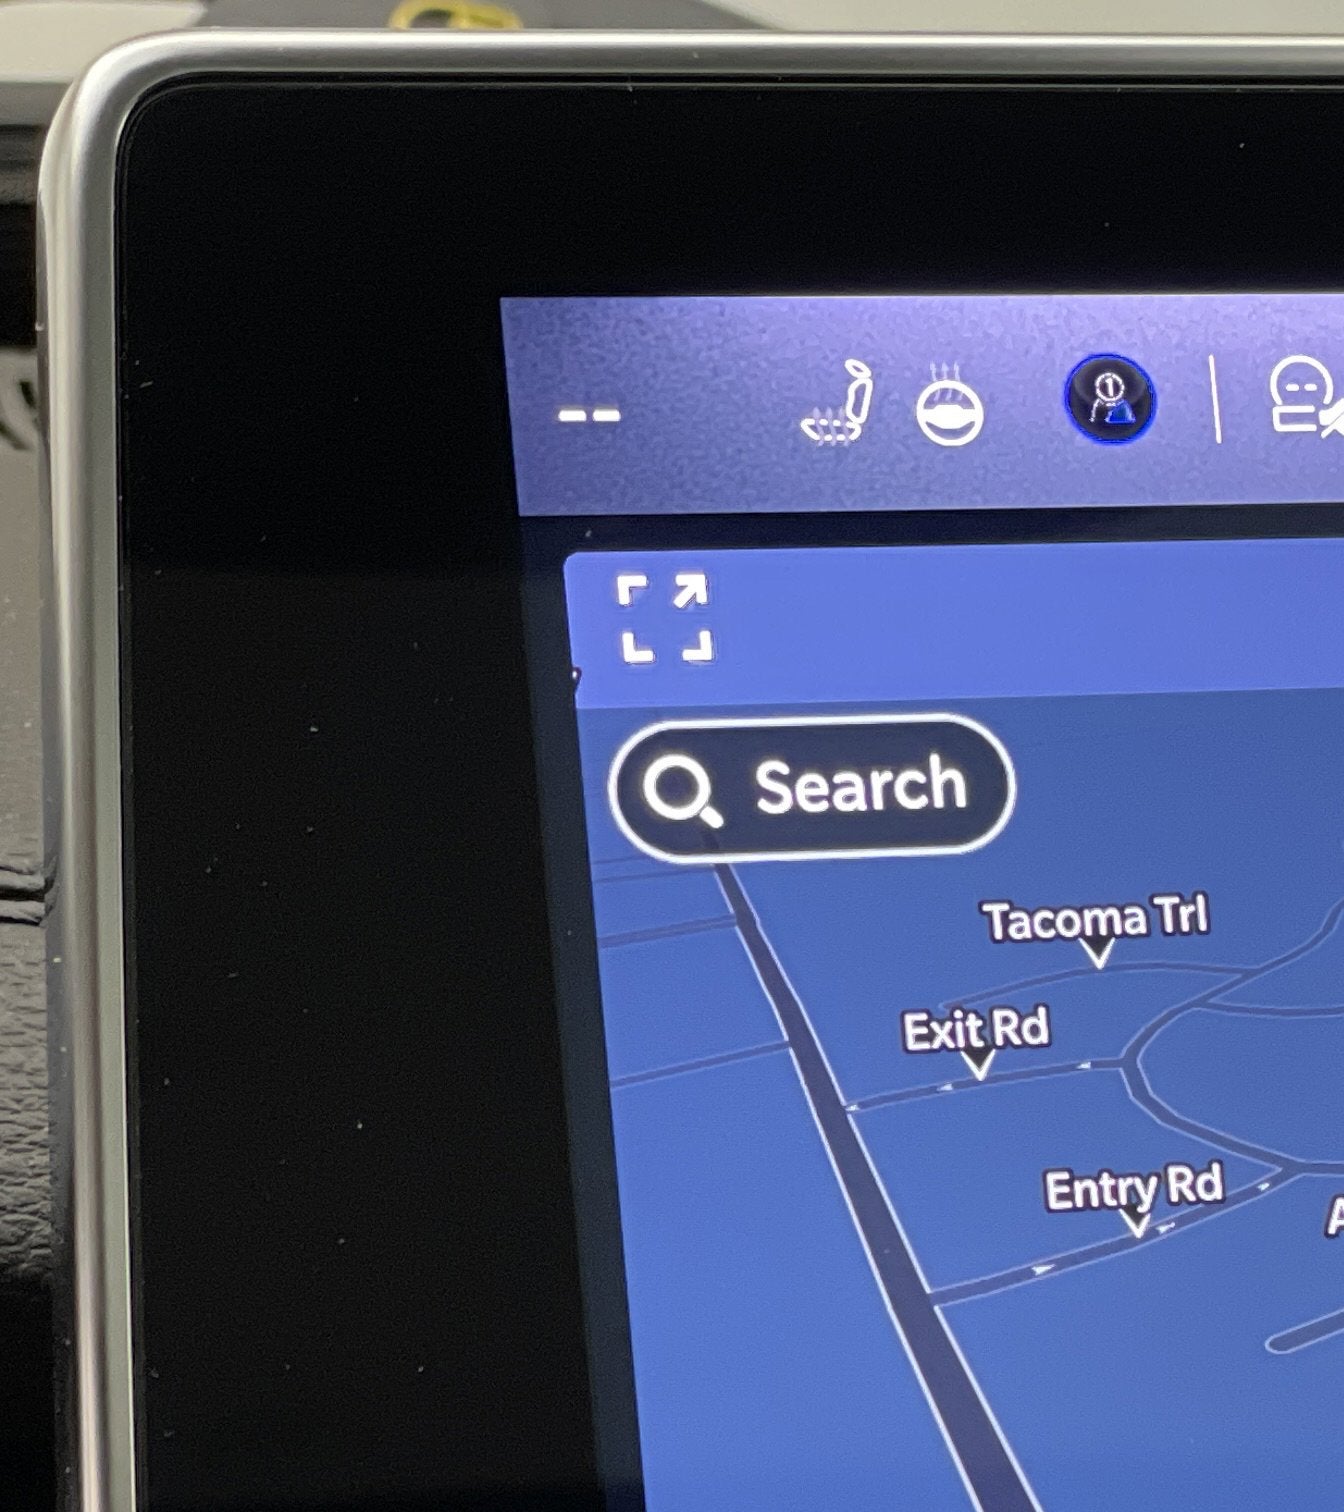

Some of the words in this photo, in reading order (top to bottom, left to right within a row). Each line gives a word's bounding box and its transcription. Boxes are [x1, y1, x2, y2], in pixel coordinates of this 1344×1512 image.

[753, 754, 968, 816] Search
[983, 901, 1148, 941] Tacoma
[1152, 895, 1210, 933] Trl
[904, 1010, 985, 1051] Exit
[992, 1006, 1050, 1046] Rd
[1045, 1171, 1158, 1212] Entry
[1166, 1164, 1222, 1202] Rd
